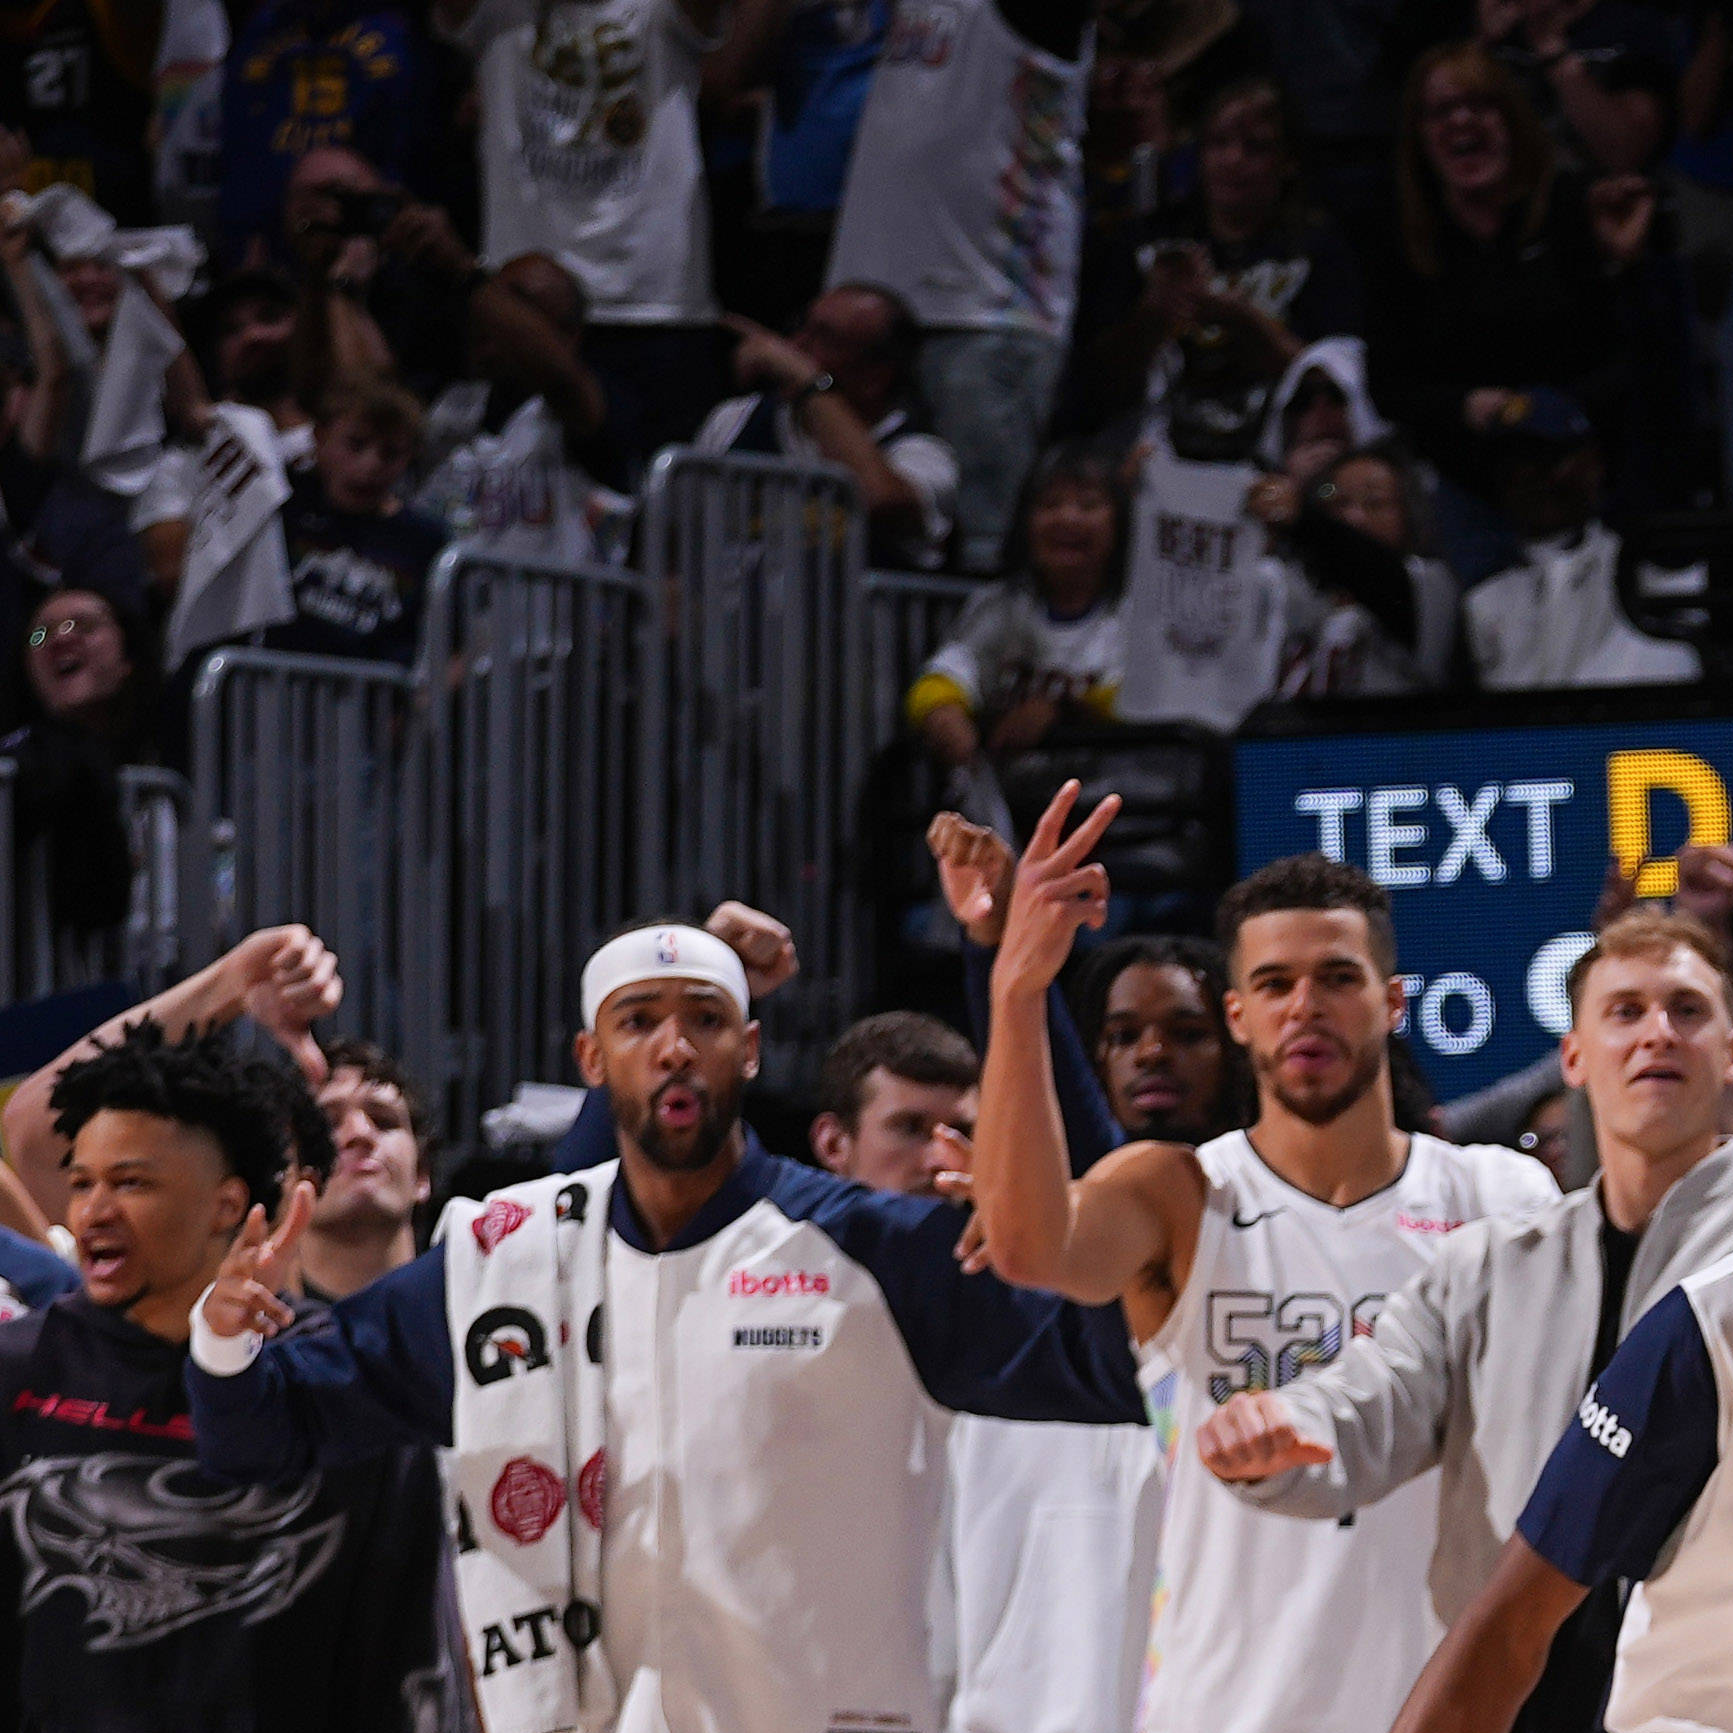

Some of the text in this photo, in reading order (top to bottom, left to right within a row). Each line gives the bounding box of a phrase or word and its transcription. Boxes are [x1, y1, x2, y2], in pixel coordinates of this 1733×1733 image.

[1295, 777, 1575, 887] TEXT
[729, 1270, 830, 1297] ibotta
[733, 1326, 822, 1349] NUGGETS
